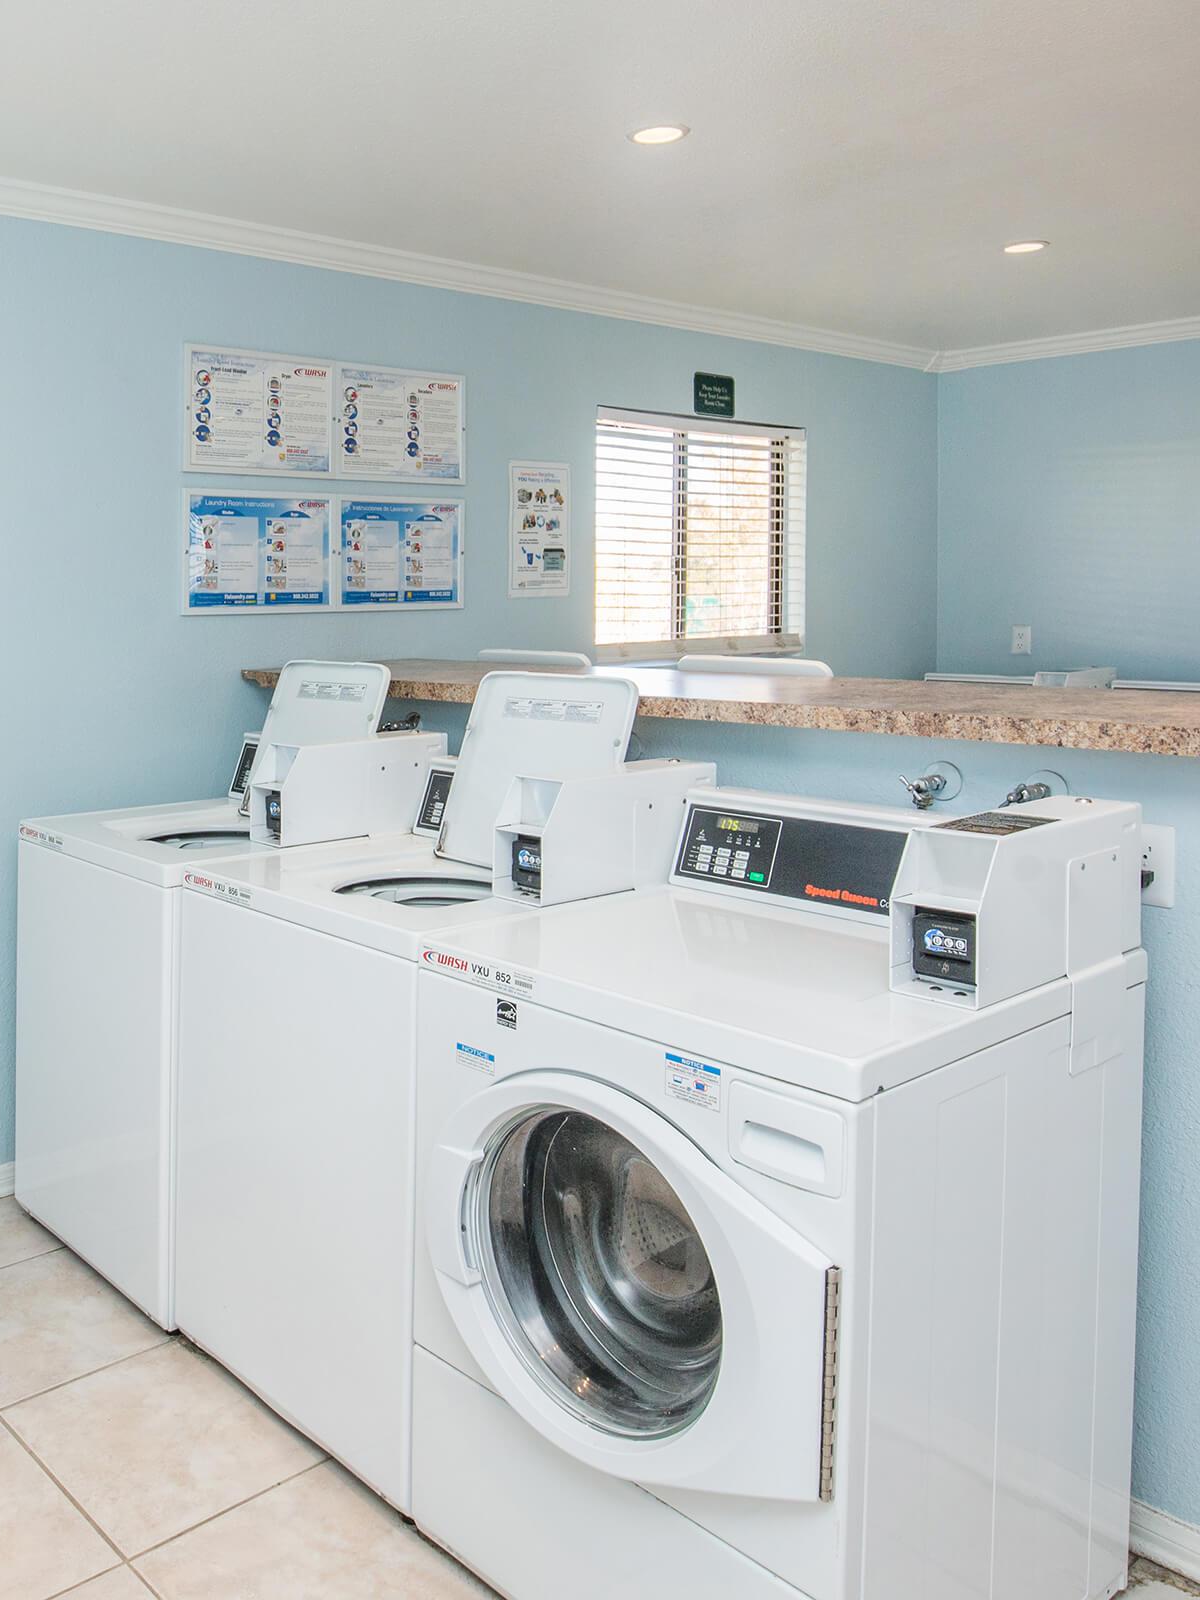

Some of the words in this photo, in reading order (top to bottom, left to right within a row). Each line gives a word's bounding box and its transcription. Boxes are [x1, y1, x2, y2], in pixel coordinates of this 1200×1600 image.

[304, 369, 327, 377] WASH
[205, 499, 227, 508] Laundry
[193, 876, 212, 888] WASH
[214, 881, 226, 892] VXU
[804, 884, 841, 900] Speed
[841, 890, 878, 907] Queen
[437, 953, 468, 972] WASH
[471, 963, 490, 977] VXU
[495, 971, 512, 985] 852
[462, 1045, 490, 1060] NOTICE
[681, 1058, 704, 1070] NOTICE
